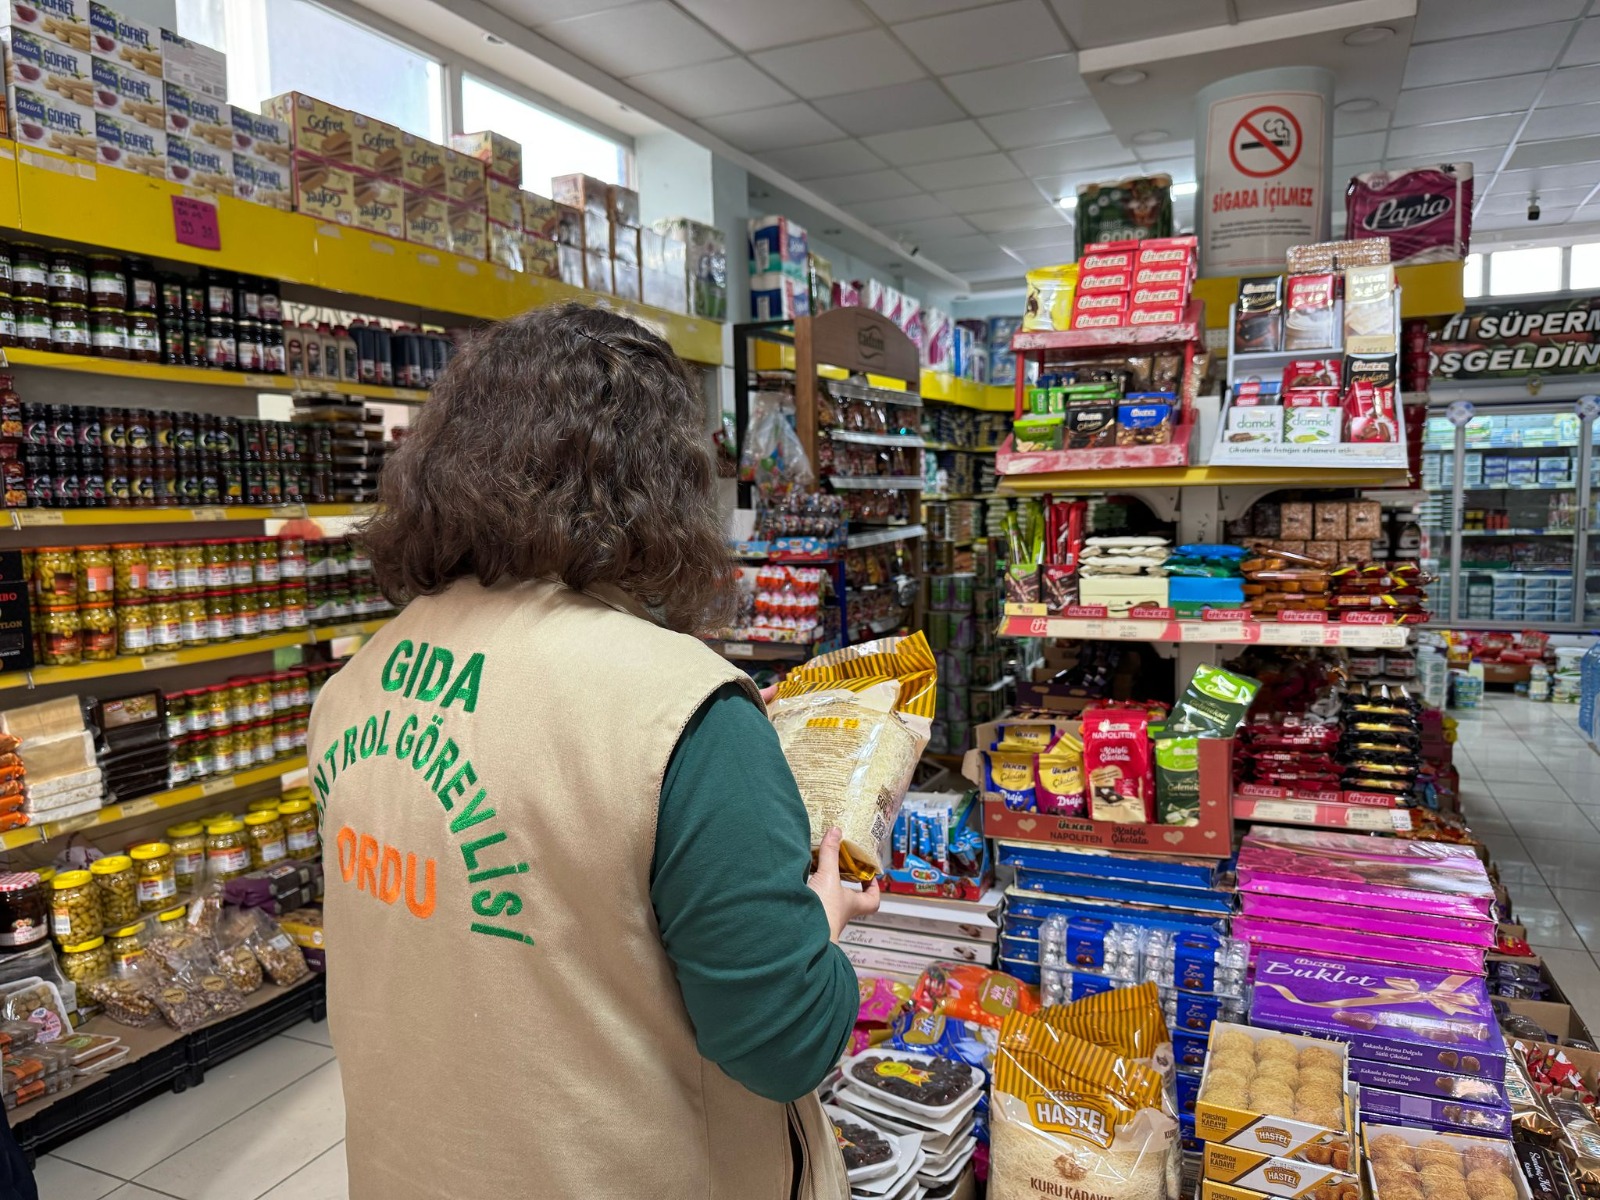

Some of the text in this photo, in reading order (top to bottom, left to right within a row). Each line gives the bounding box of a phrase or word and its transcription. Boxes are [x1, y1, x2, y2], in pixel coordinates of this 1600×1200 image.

[119, 23, 149, 45] GOFRET
[44, 50, 78, 74] GOFRET
[121, 77, 150, 99] GOFRET
[48, 108, 81, 131] GOFRET
[308, 114, 344, 137] Gofret
[124, 131, 154, 153] GOFRET
[363, 132, 395, 152] Gofret
[411, 152, 439, 169] Gofret
[1212, 182, 1313, 213] SİGARA İÇİLMEZ
[1370, 193, 1447, 230] Papia
[1430, 342, 1600, 379] ŞGELDİN
[1237, 416, 1276, 429] damak
[1291, 412, 1332, 427] damak
[381, 639, 485, 713] GIDA
[1056, 795, 1084, 807] Draje
[395, 713, 535, 947] GÖREVLİSİ
[1058, 820, 1093, 831] ÜLKER
[1050, 831, 1103, 844] NAPOLİTEN
[337, 824, 437, 920] ORDU
[1263, 961, 1379, 987] Buklet
[1362, 1042, 1383, 1050] Kakaolu
[1402, 1048, 1423, 1057] Dolgulu
[1375, 1049, 1411, 1061] Sütlü Çikolata
[1360, 1067, 1421, 1082] Kakaolu Krema Dolgulu
[1373, 1075, 1409, 1086] Sütlü Çikolata
[1036, 1102, 1109, 1138] HASTEL
[1259, 1131, 1289, 1144] HASTEL
[1210, 1151, 1236, 1161] PORSİYON
[1210, 1159, 1236, 1170] KADAYIF
[1030, 1177, 1063, 1197] KURU
[1268, 1171, 1296, 1185] HASTEL
